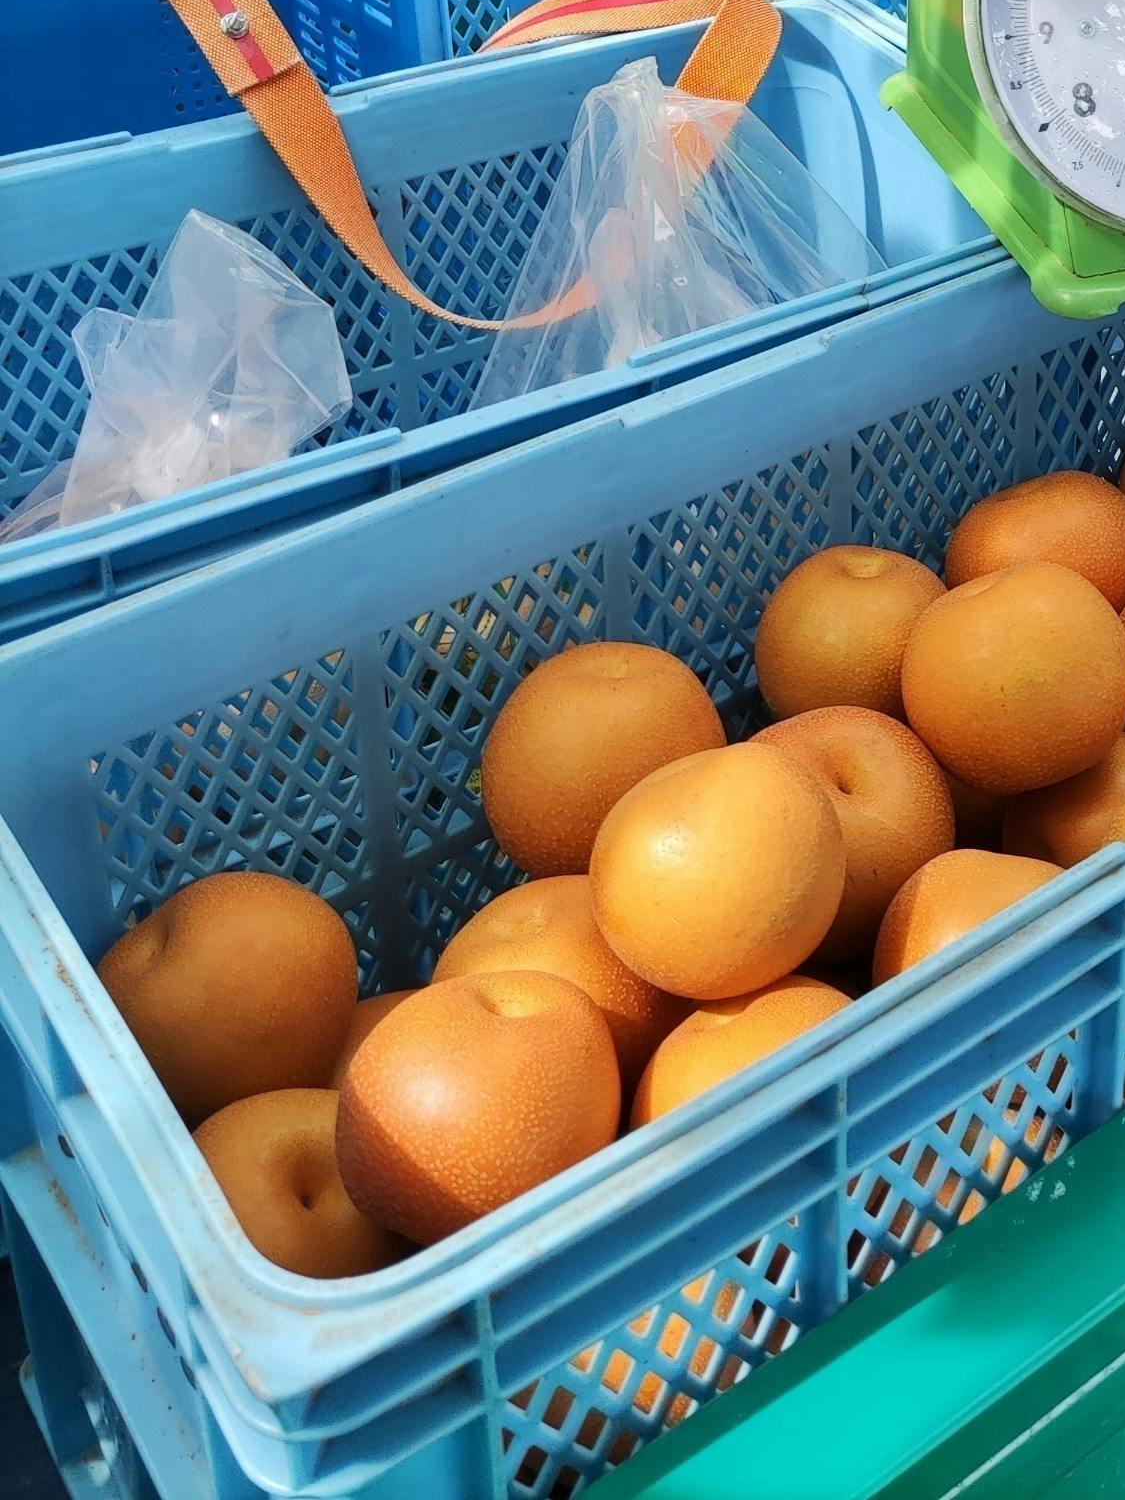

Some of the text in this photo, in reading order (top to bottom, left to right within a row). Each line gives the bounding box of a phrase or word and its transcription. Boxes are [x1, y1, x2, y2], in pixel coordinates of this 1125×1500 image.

[1038, 21, 1054, 44] 9
[1009, 80, 1023, 90] 8.5
[1072, 82, 1097, 118] 8
[1071, 161, 1084, 171] 7.5
